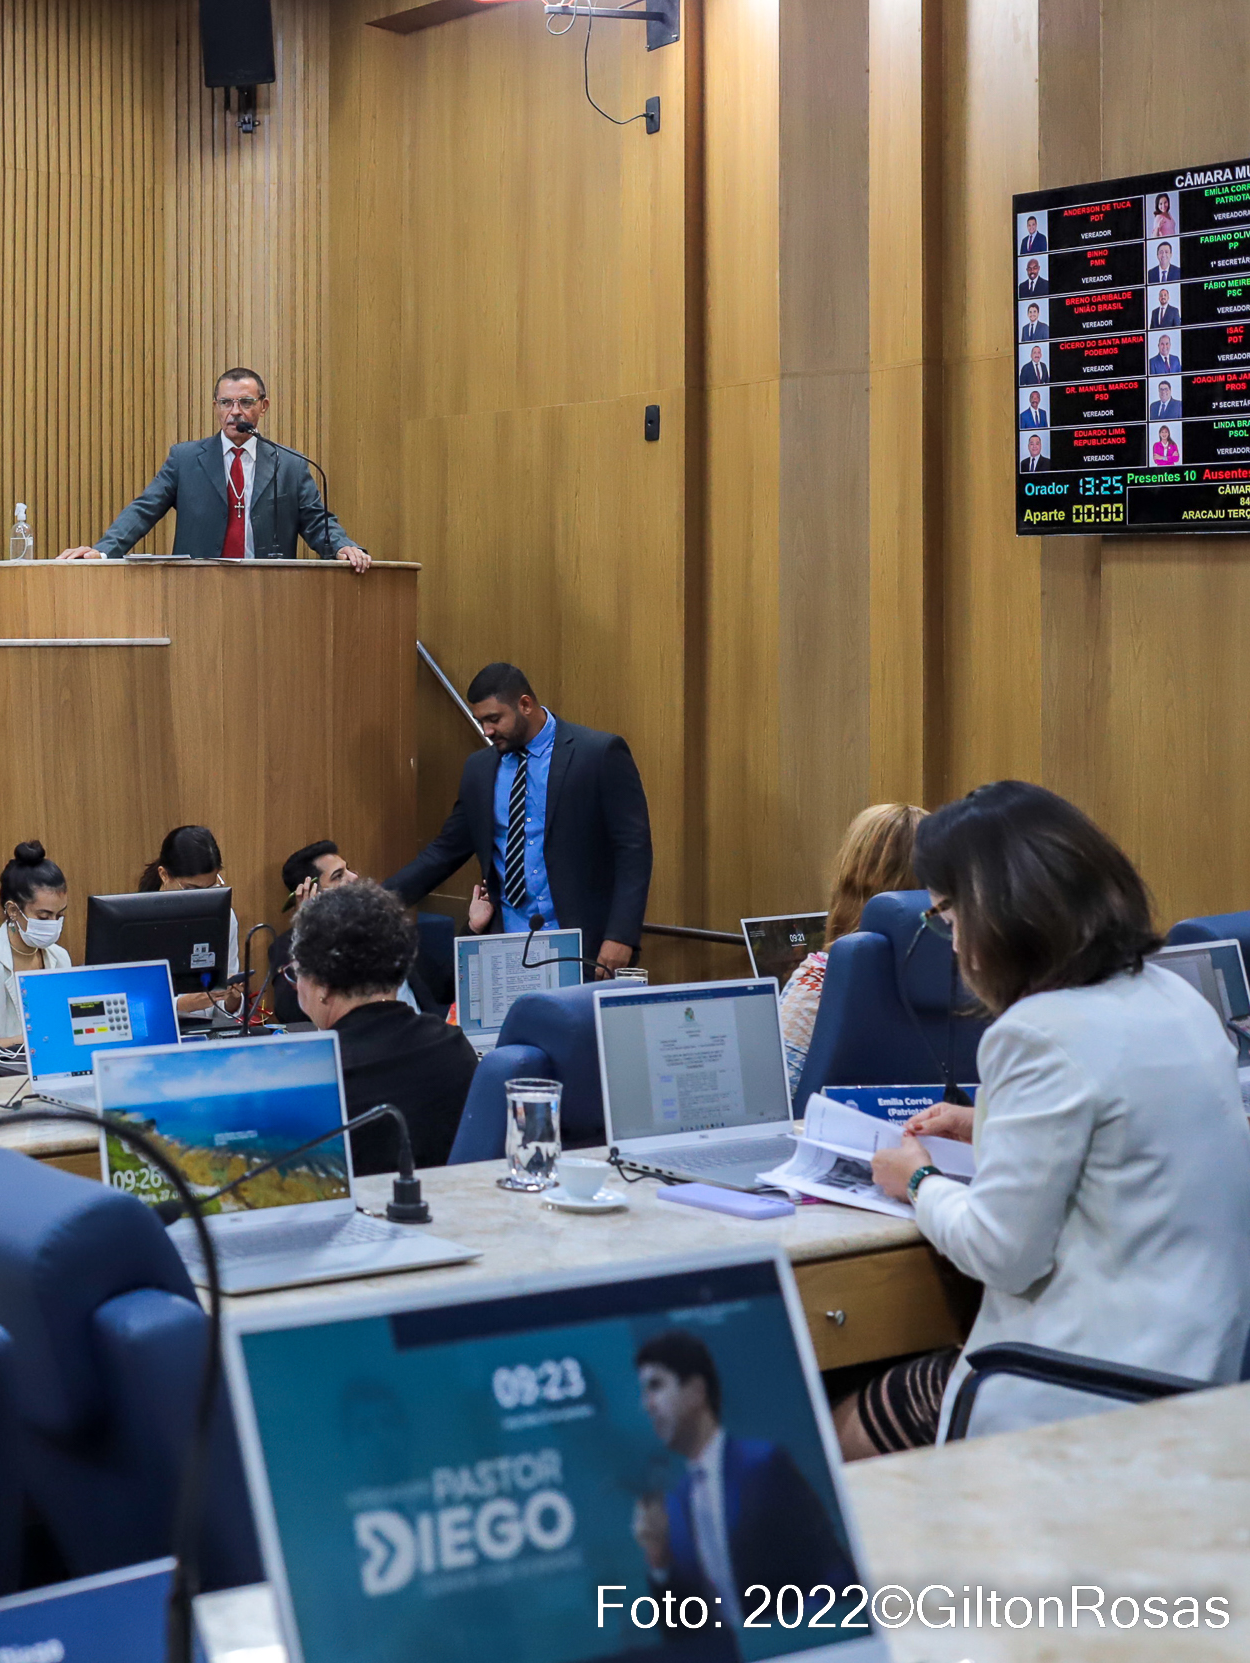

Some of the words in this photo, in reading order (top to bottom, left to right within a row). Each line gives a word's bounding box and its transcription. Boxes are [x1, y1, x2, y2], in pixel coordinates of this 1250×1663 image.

[1175, 168, 1233, 188] CÂMARA
[1204, 186, 1230, 197] EMÍLIA
[1215, 193, 1250, 205] PATRIOTA
[1063, 205, 1100, 217] ANDERSON
[1101, 203, 1111, 212] DE
[1112, 200, 1132, 210] TUCA
[1090, 213, 1104, 222] PDT
[1080, 229, 1112, 240] VEREADOR
[1200, 233, 1233, 244] FABIANO
[1228, 241, 1239, 250] PP
[1086, 249, 1109, 259] BINHO
[1090, 258, 1106, 267] PMN
[1081, 274, 1113, 284] VEREADOR
[1203, 280, 1227, 290] FÁBIO
[1226, 288, 1243, 298] PSC
[1065, 296, 1090, 306] BRENO
[1091, 291, 1132, 303] GARIBALDE
[1073, 304, 1097, 315] UNIÃO
[1097, 302, 1124, 312] BRASIL
[1216, 304, 1250, 314] VEREADOR
[1082, 319, 1113, 329] VEREADOR
[1226, 325, 1245, 334] ISAC
[1059, 341, 1085, 351] CÍCERO
[1086, 340, 1097, 348] DO
[1097, 338, 1120, 347] SANTA
[1121, 335, 1144, 345] MARIA
[1084, 347, 1119, 357] PODEMOS
[1217, 352, 1250, 362] VEREADOR
[1082, 364, 1114, 373] VEREADOR
[1191, 374, 1226, 384] JOAQUIM
[1226, 373, 1238, 382] DA
[1065, 386, 1077, 394] DR.
[1078, 384, 1107, 393] MANUEL
[1108, 381, 1139, 391] MARCOS
[1225, 382, 1248, 391] PROS
[1094, 393, 1110, 401] PSD
[1082, 409, 1114, 418] VEREADOR
[1213, 421, 1236, 429] LINDA
[1074, 429, 1107, 438] EDUARDO
[1108, 427, 1126, 436] LIMA
[1228, 429, 1249, 438] PSOL
[1073, 437, 1127, 447] REPUBLICANOS
[1083, 454, 1115, 462] VEREADOR
[1127, 472, 1181, 484] Presentes
[1184, 469, 1197, 481] 10
[1024, 482, 1070, 496] Orador
[1079, 475, 1123, 496] 13:25
[1023, 508, 1066, 525] Aparte
[1072, 502, 1124, 523] 00:00
[1181, 509, 1225, 520] ARACAJU
[112, 1167, 163, 1193] 09:26
[492, 1356, 587, 1410] 09:23
[432, 1447, 564, 1505] PASTOR
[353, 1487, 576, 1597] DIEGO
